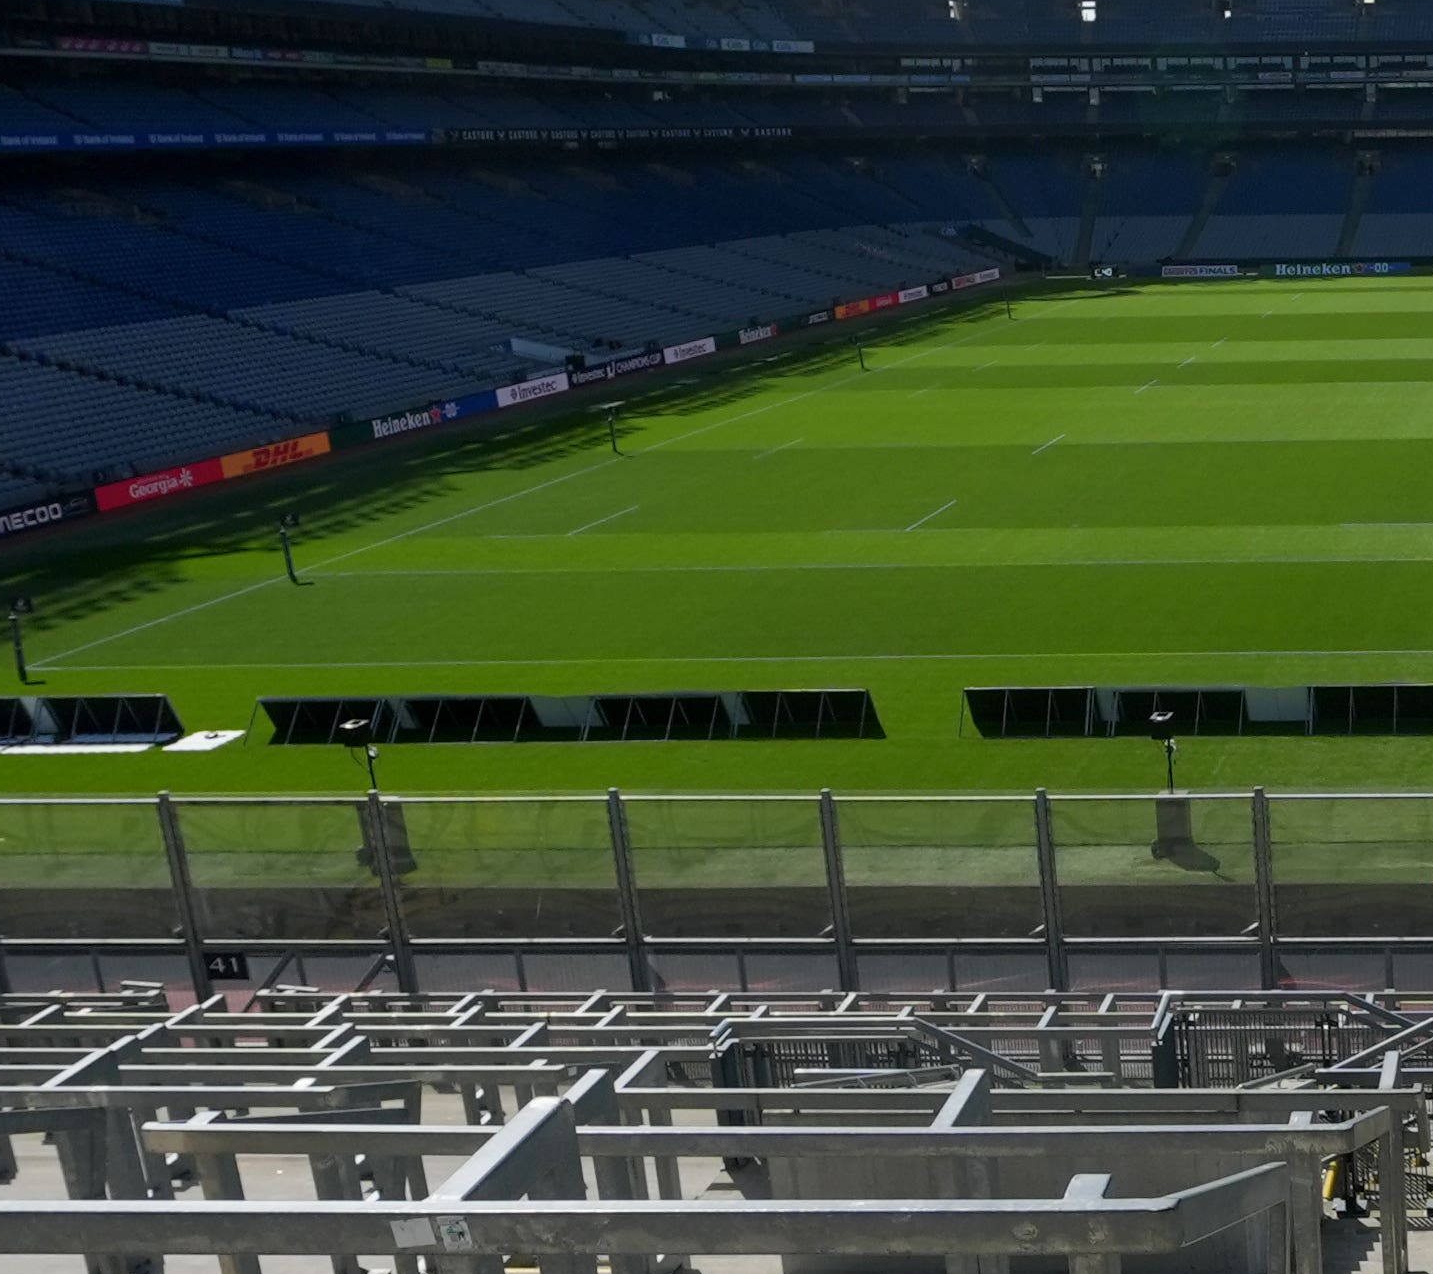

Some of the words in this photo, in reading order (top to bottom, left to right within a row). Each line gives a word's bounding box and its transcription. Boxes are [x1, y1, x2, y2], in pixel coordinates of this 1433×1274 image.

[1275, 263, 1351, 276] Heineken
[371, 408, 431, 439] Heineken
[252, 441, 303, 469] DHL
[128, 476, 179, 500] Georgia
[208, 956, 239, 973] 41
